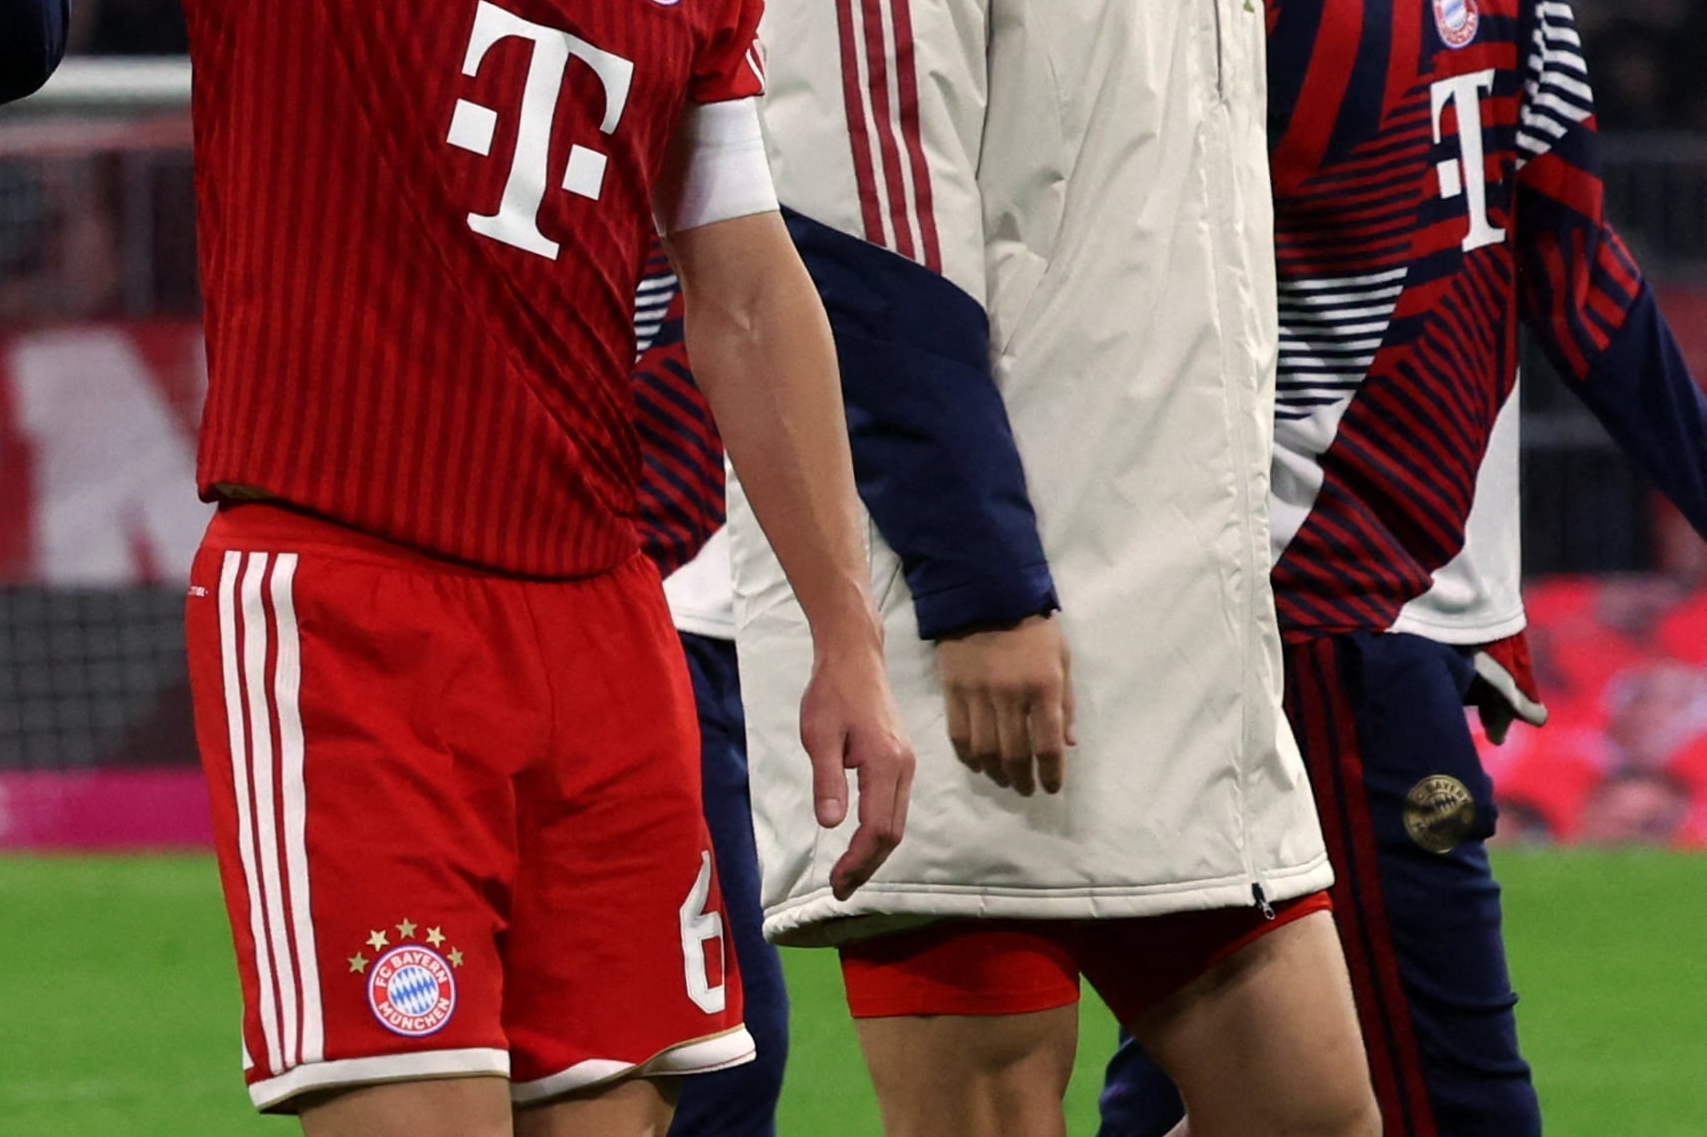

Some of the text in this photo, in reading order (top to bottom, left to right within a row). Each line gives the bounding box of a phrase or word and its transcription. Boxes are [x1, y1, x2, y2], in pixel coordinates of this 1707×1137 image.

[446, 0, 635, 261] T
[1430, 68, 1507, 253] T
[375, 951, 448, 988] FC BAYERN
[679, 849, 726, 1014] 6
